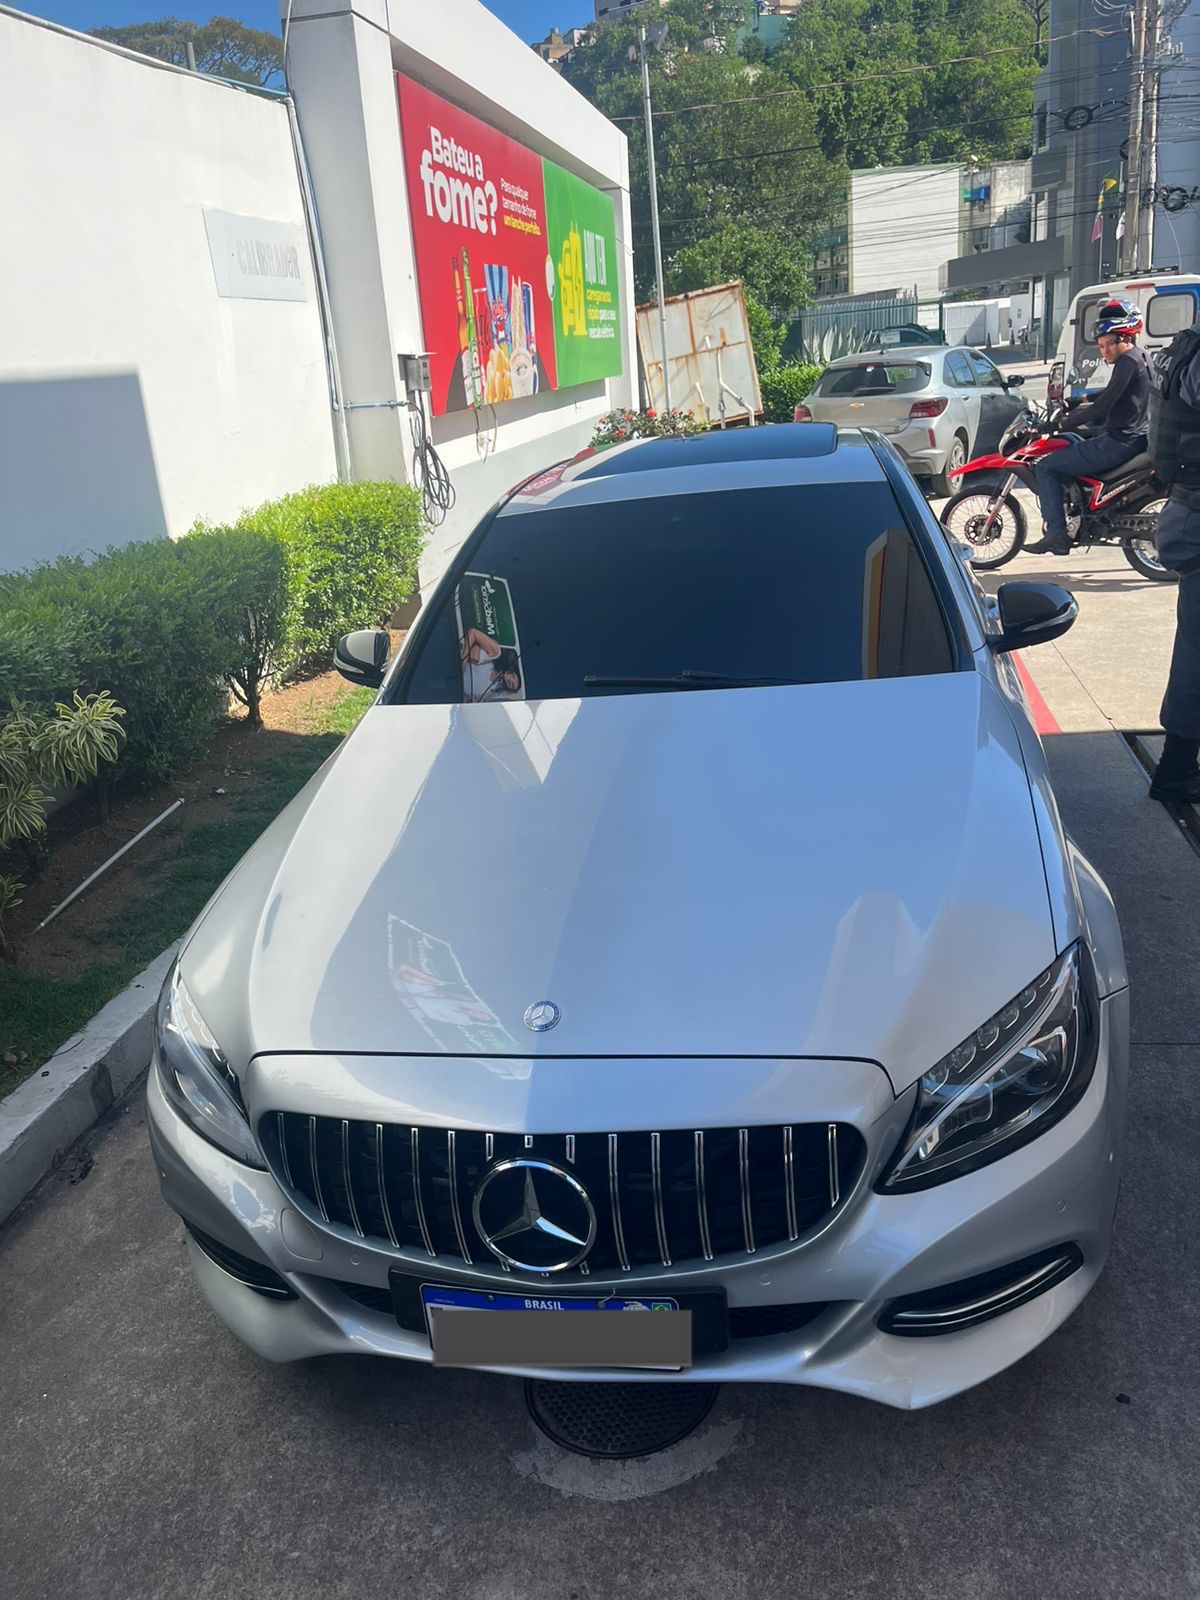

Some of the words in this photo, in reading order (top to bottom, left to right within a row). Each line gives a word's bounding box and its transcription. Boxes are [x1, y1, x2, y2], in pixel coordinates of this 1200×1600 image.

[430, 126, 475, 178] Bateu
[475, 154, 484, 181] a
[420, 149, 498, 236] fome?
[524, 1299, 565, 1311] BRASIL
